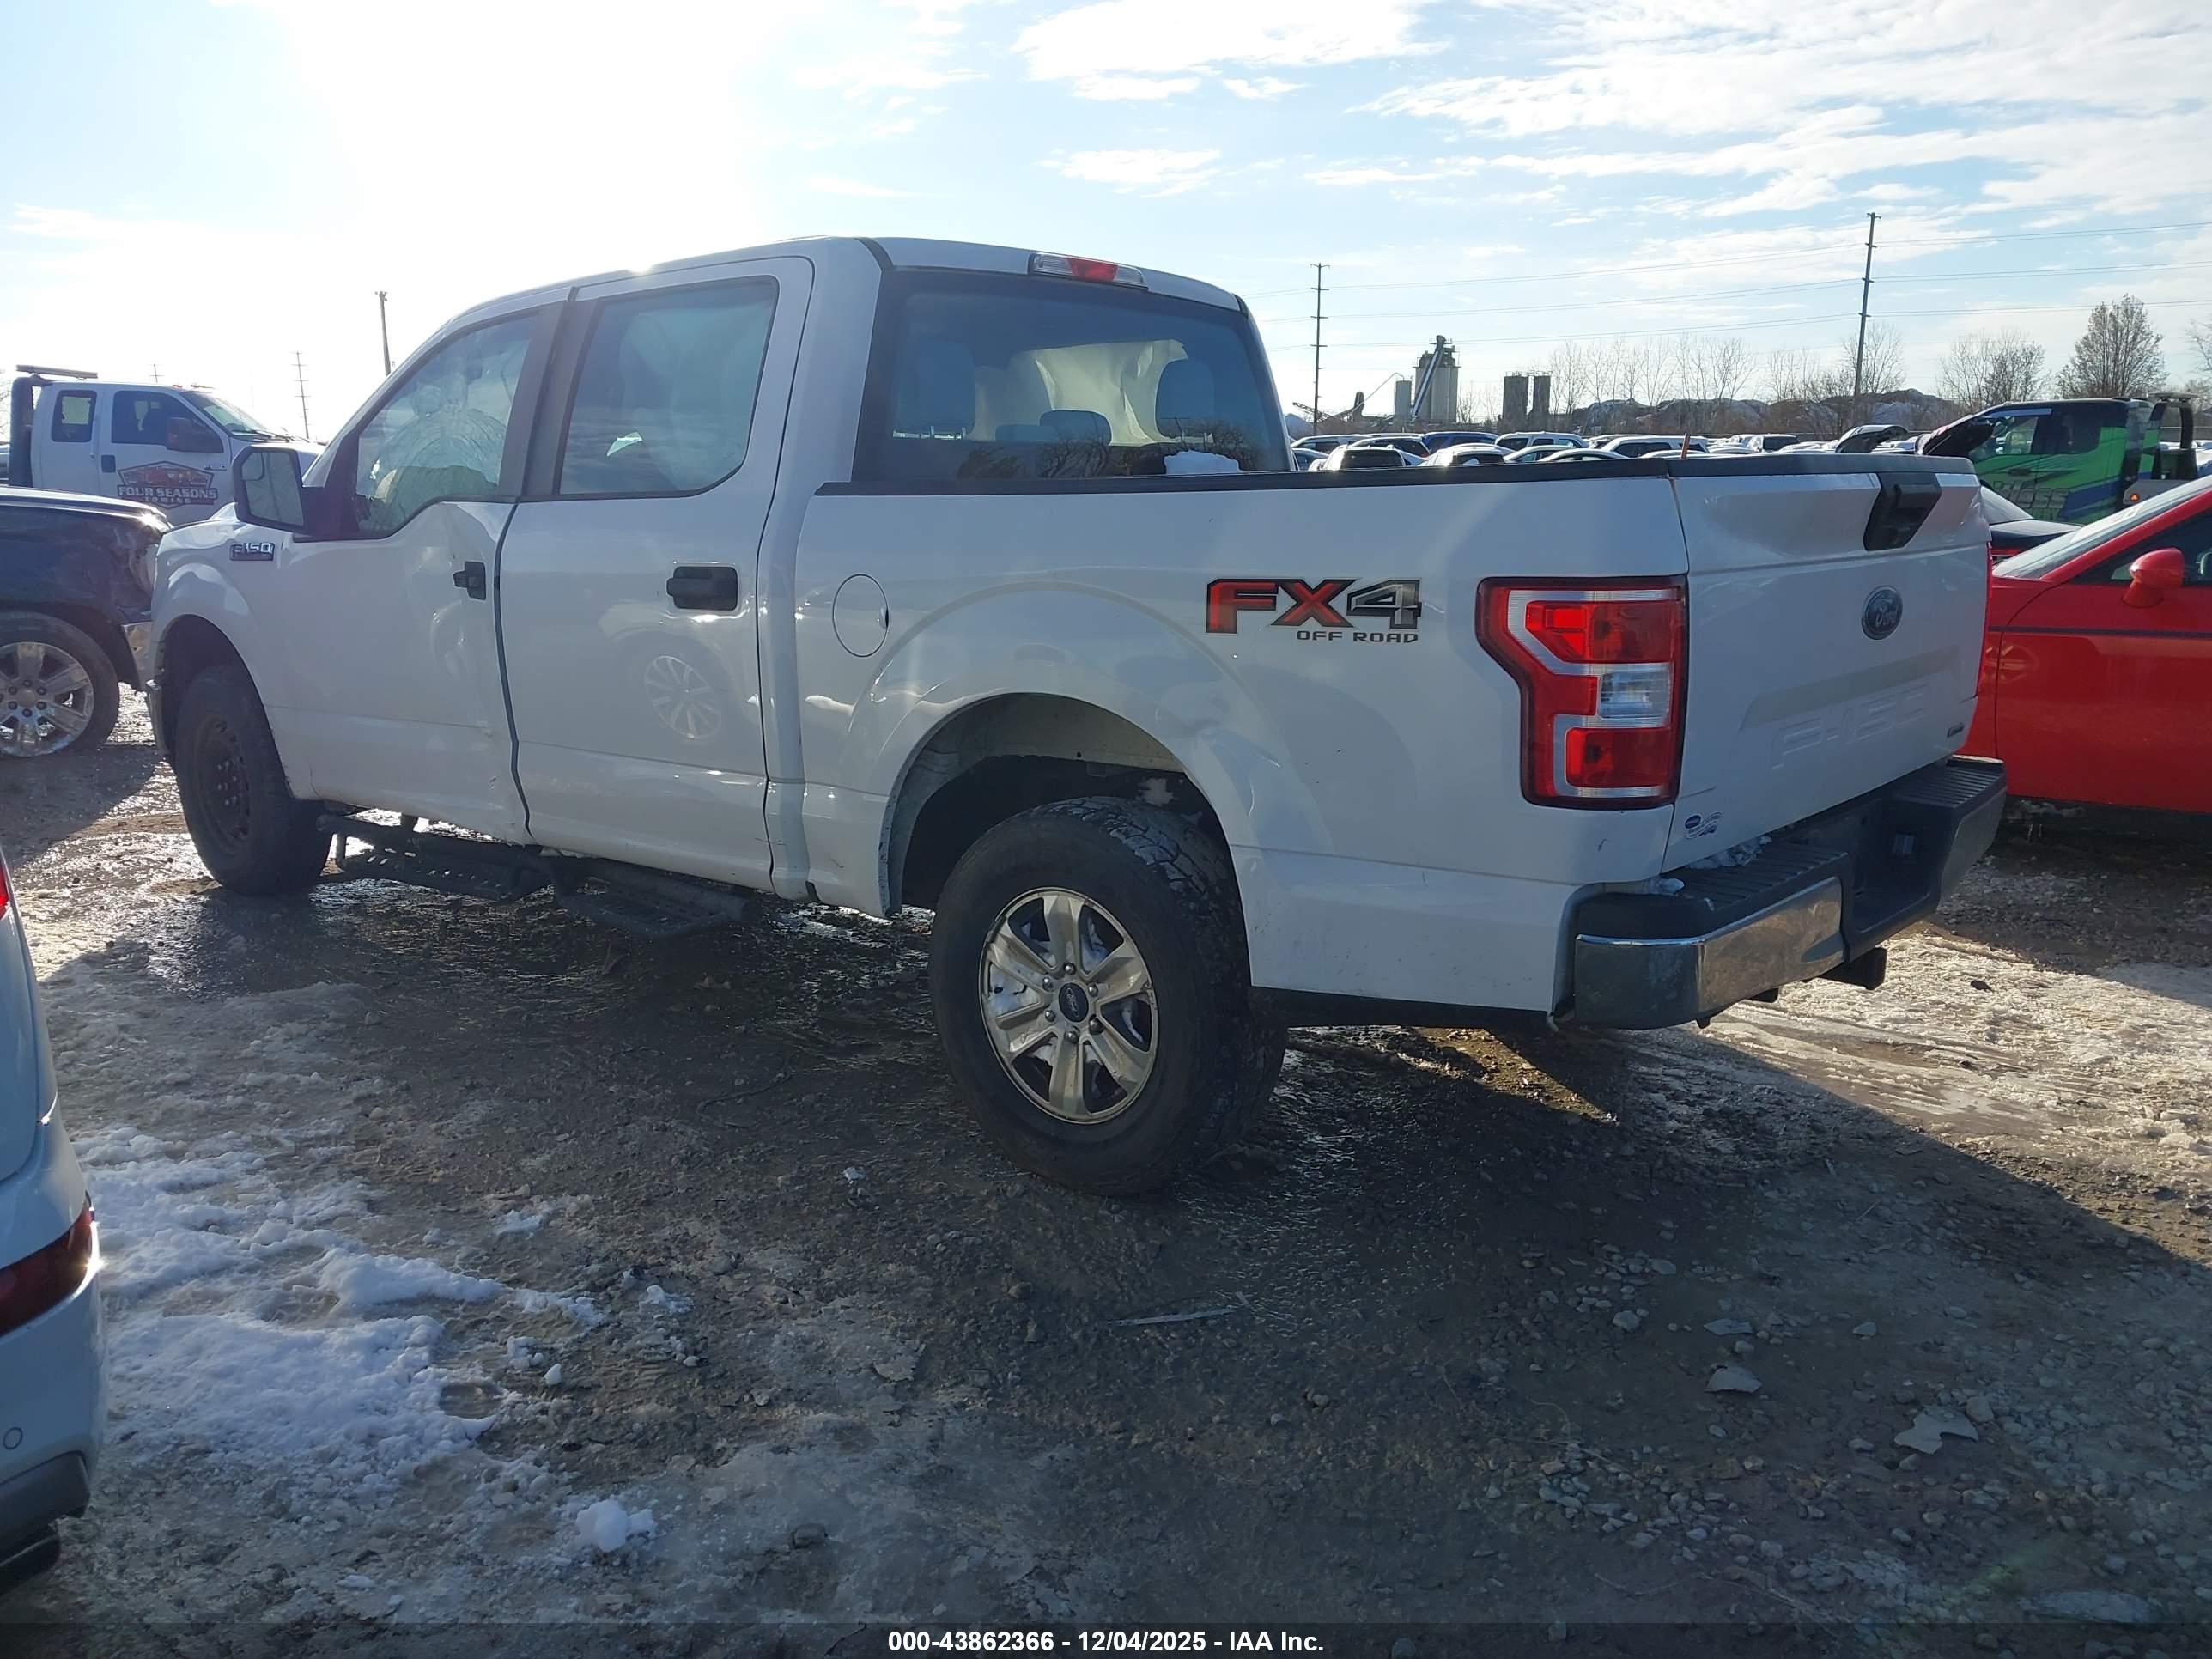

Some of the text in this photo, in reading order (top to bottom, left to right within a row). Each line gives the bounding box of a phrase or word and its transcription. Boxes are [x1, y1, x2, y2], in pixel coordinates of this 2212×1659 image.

[118, 486, 217, 499] FOUR SEASONS
[1206, 579, 1422, 634] FX4
[1297, 630, 1419, 643] OFF ROAD
